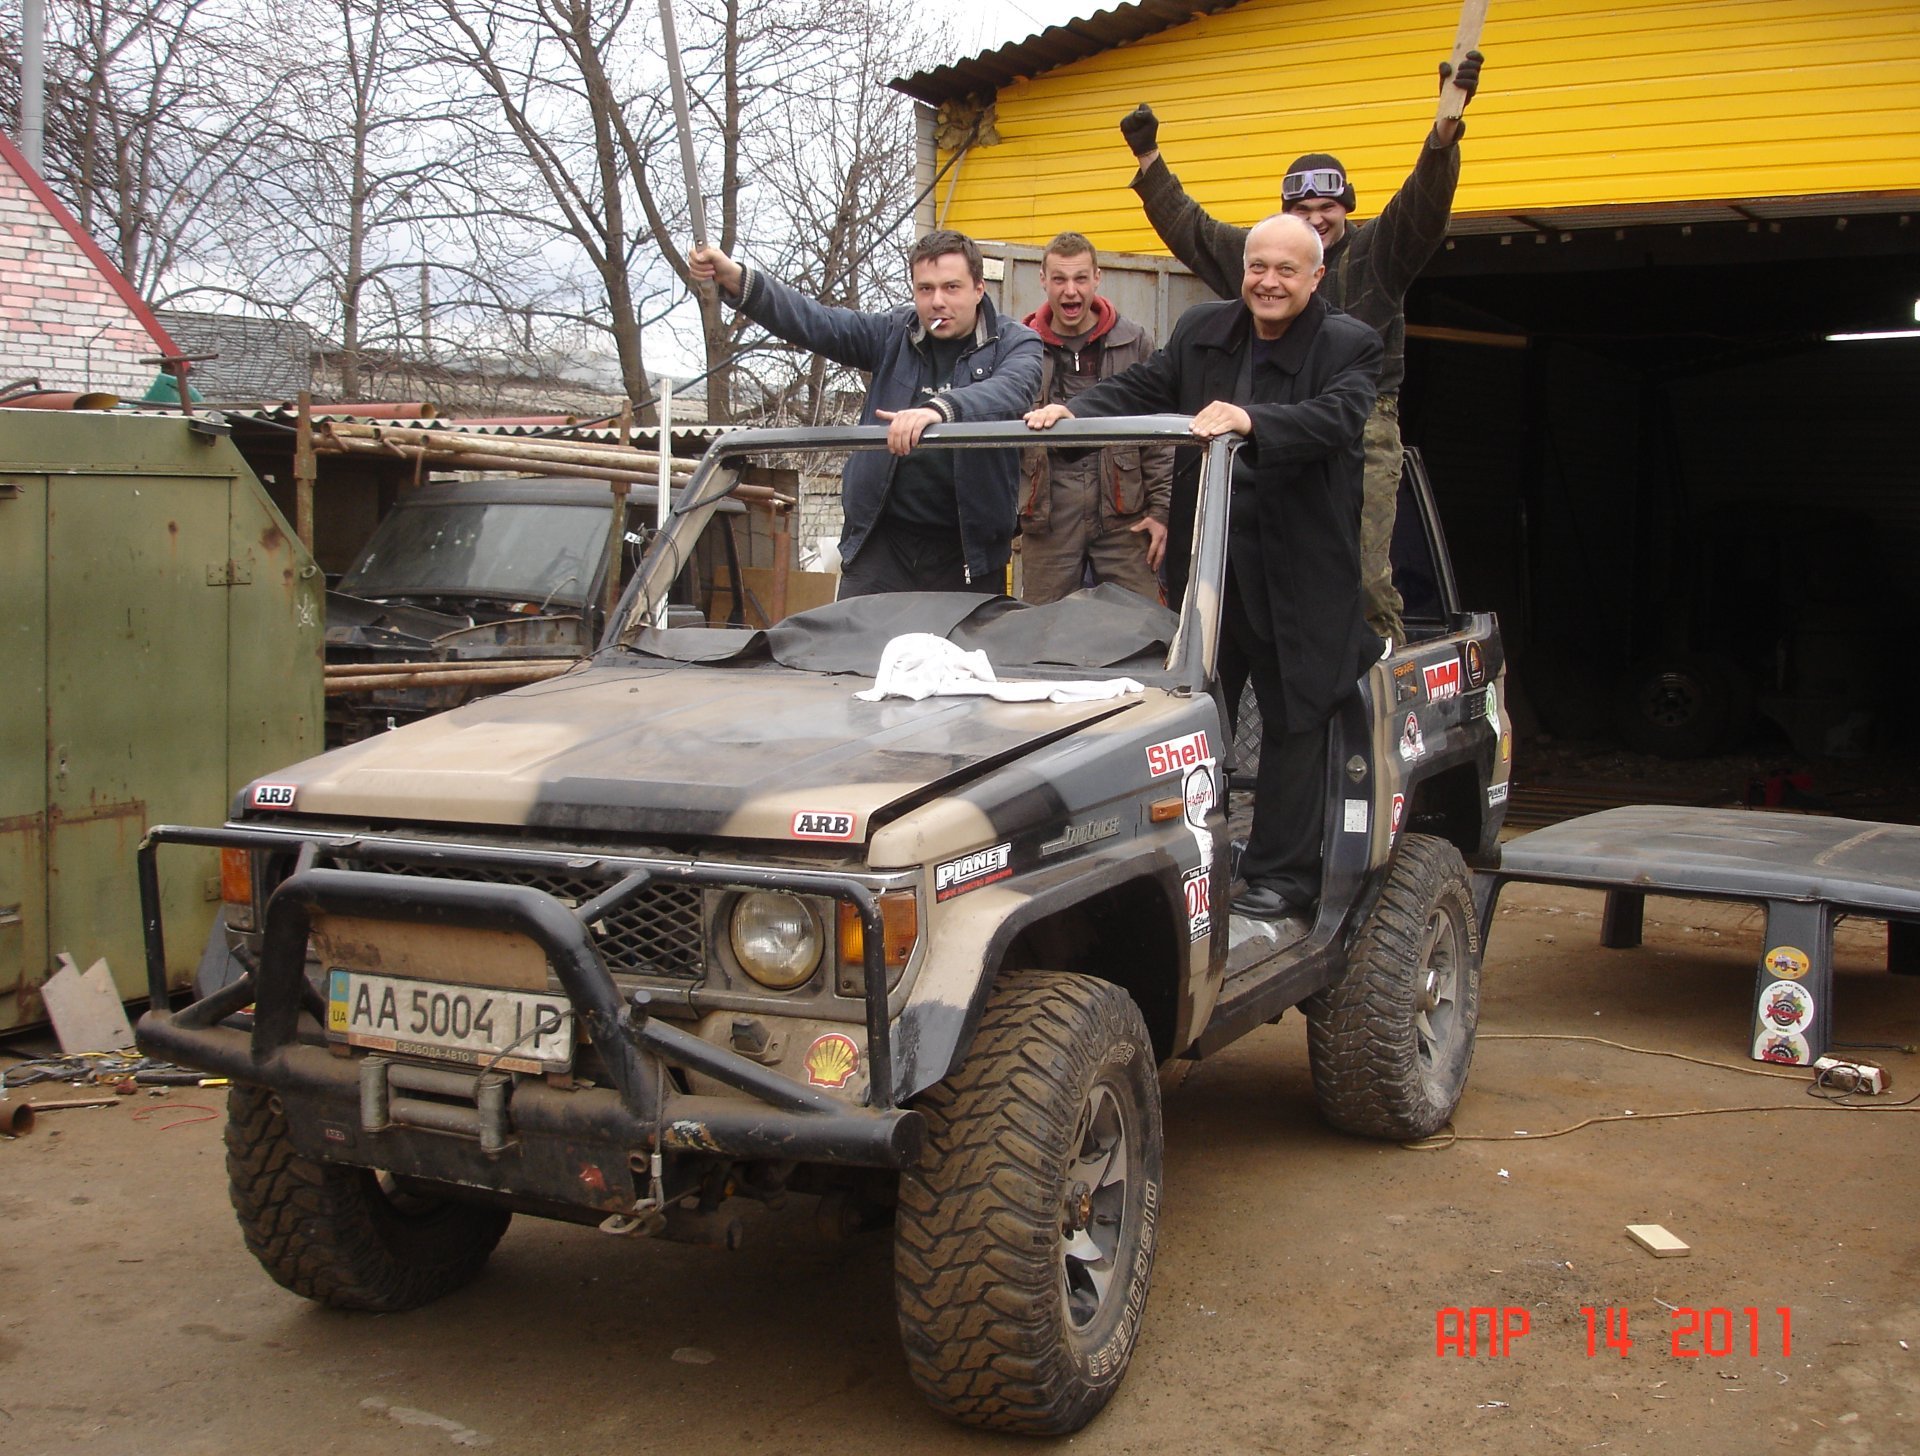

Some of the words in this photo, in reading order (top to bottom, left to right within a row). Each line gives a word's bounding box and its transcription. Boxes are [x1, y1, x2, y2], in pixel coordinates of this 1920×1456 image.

[1148, 734, 1208, 775] Shell
[257, 788, 292, 803] ARB
[797, 814, 850, 834] ARB
[937, 843, 1012, 890] PLANET
[332, 1010, 347, 1023] UA
[353, 983, 399, 1031] AA
[410, 990, 494, 1044] 5004
[515, 1001, 562, 1049] IP
[397, 1041, 470, 1062] СВОБОДА-АВТО
